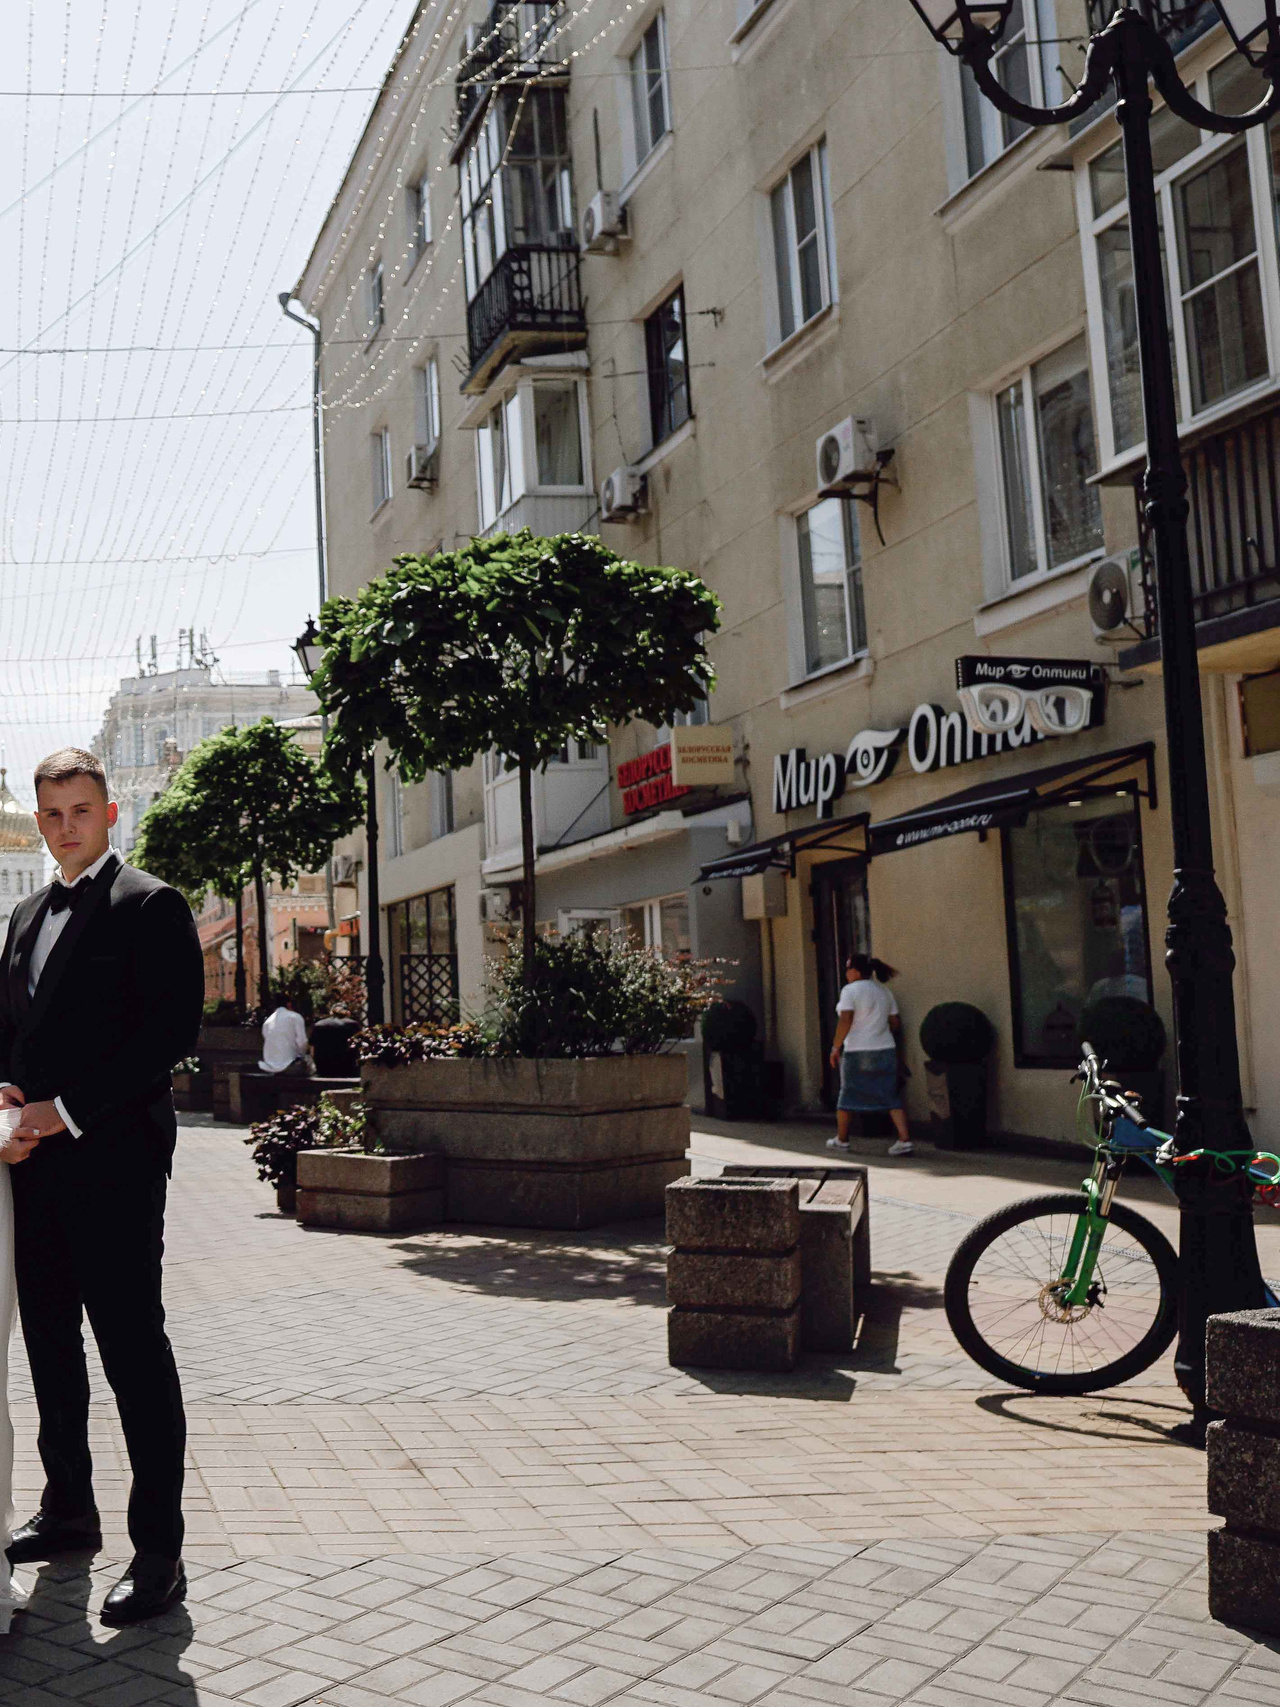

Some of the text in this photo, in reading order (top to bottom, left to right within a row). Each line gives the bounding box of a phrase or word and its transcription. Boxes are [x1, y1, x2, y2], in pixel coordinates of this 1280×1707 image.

[975, 662, 1087, 680] Мир Оптики
[772, 748, 837, 820] Мир
